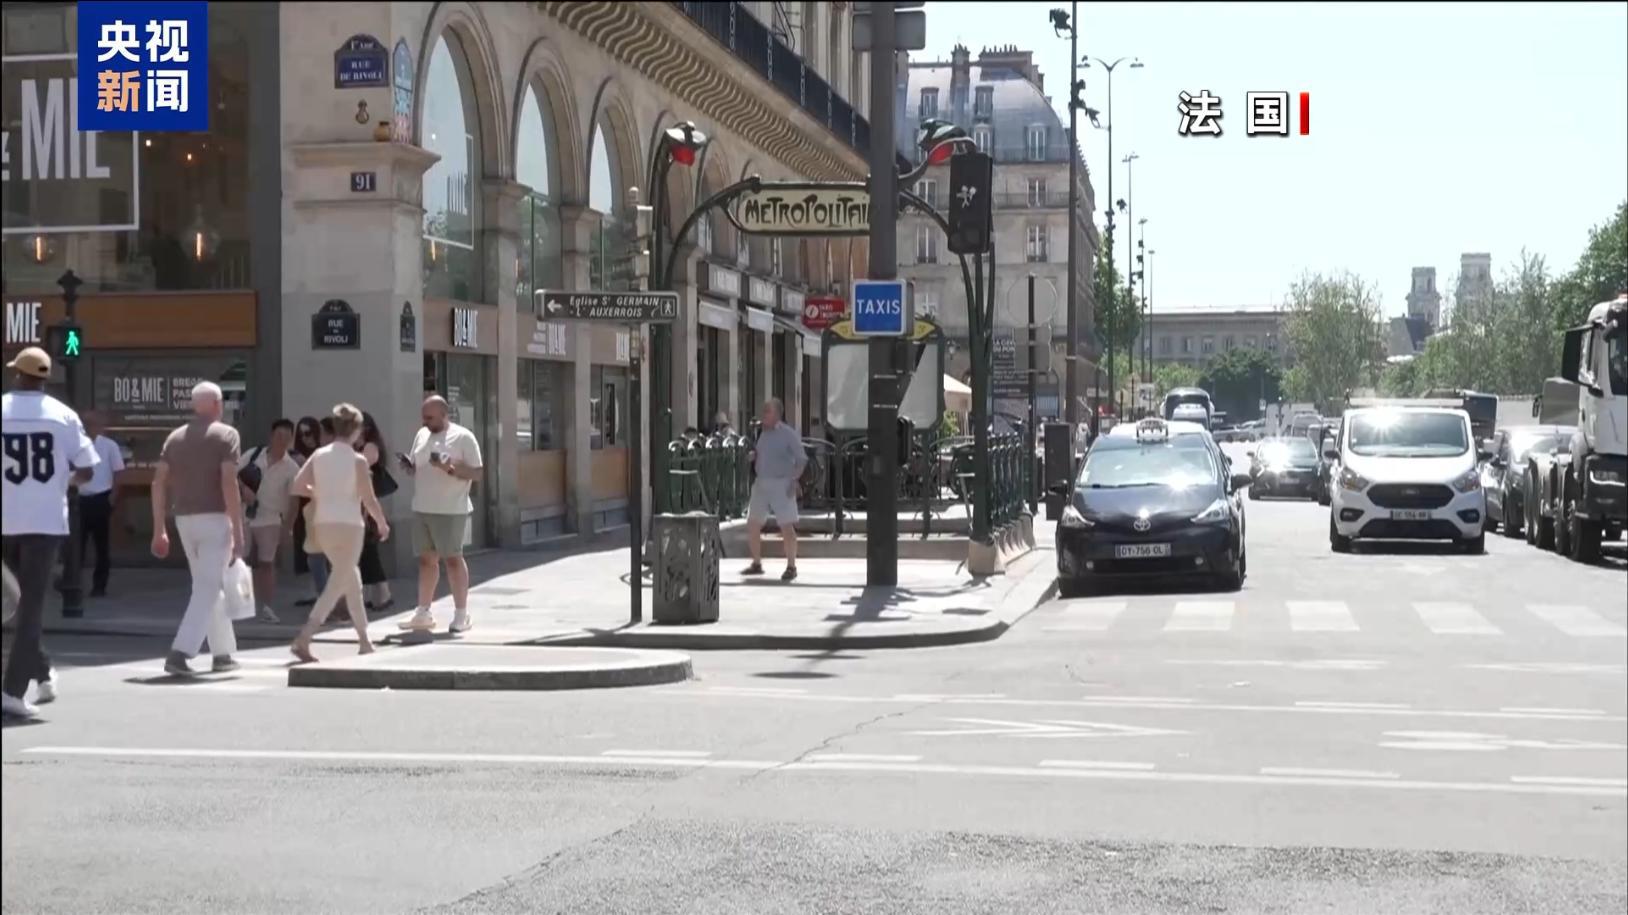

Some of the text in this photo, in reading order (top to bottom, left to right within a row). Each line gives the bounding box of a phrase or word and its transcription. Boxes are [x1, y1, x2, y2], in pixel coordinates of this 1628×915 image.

[351, 61, 370, 69] RUE
[355, 174, 370, 190] 91
[745, 193, 870, 228] METROPOLITAI
[616, 295, 660, 306] GERMAIN
[857, 299, 901, 315] TAXIS
[6, 302, 42, 343] MIE
[328, 319, 344, 328] RUE
[323, 335, 348, 344] RIVOLI
[114, 377, 164, 402] BO&MIE
[3, 432, 55, 484] 98
